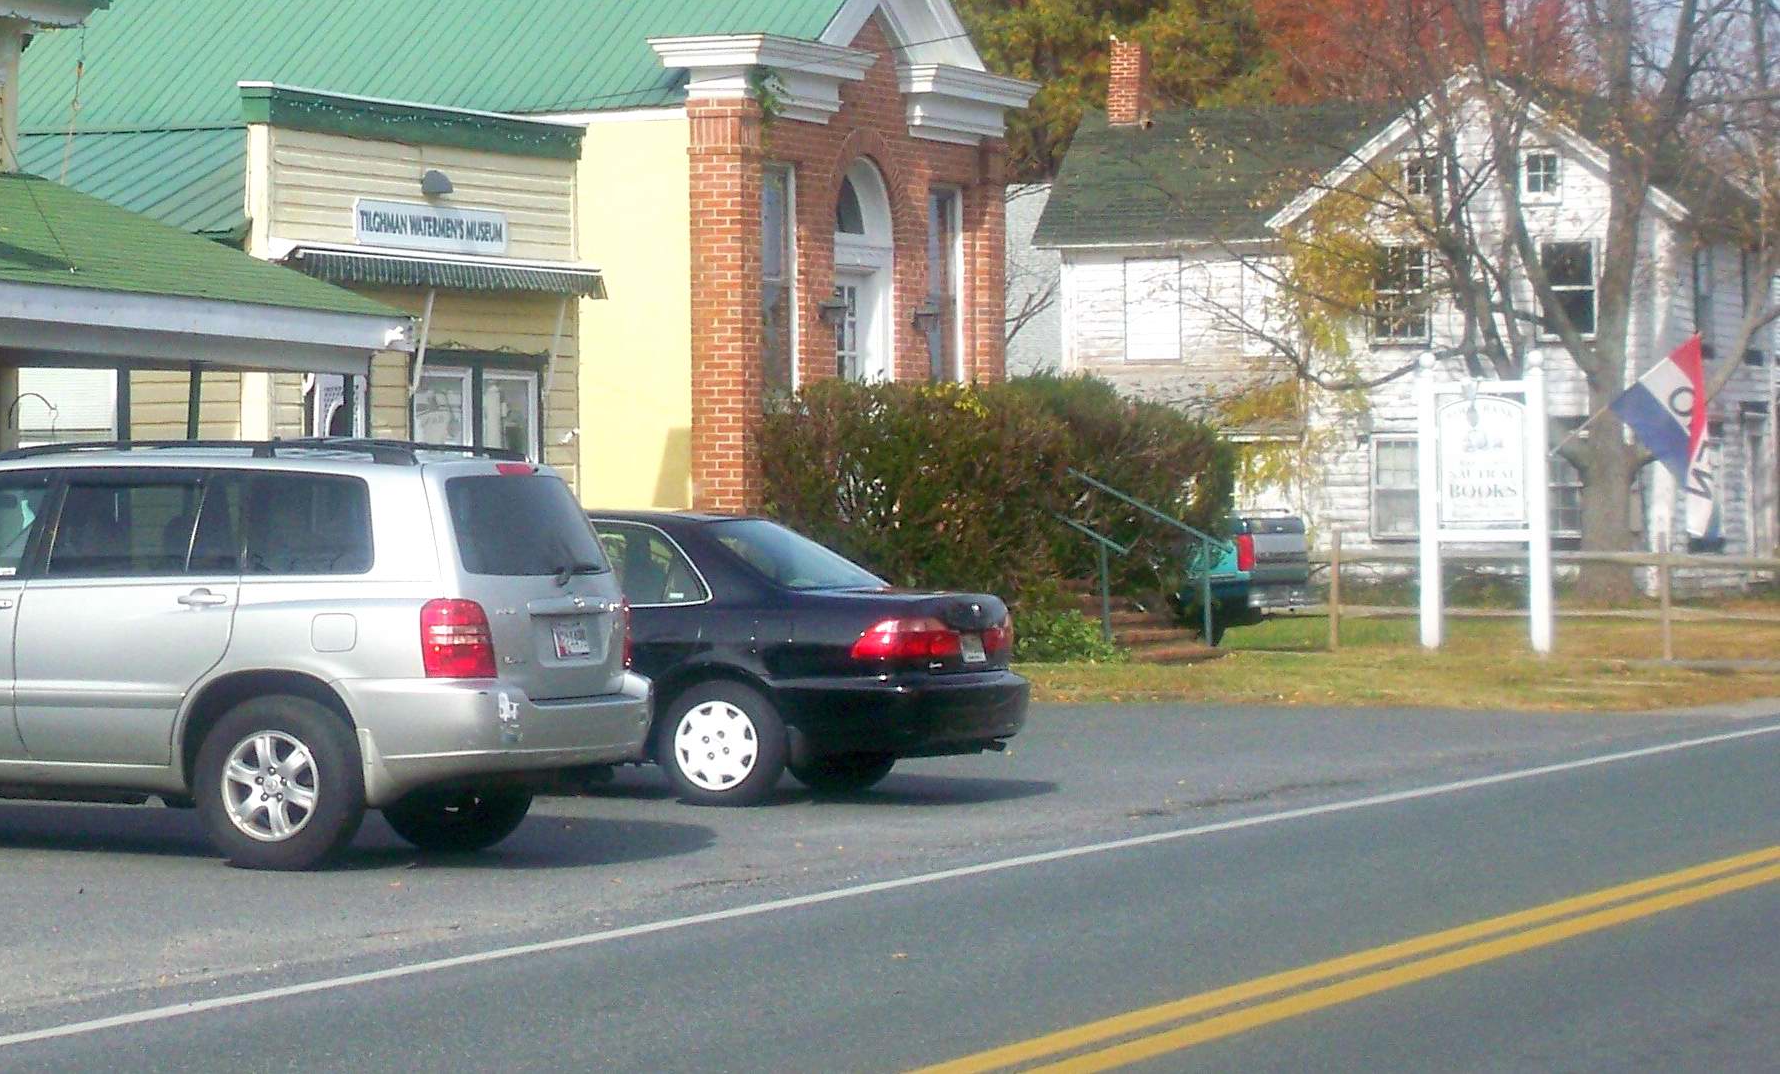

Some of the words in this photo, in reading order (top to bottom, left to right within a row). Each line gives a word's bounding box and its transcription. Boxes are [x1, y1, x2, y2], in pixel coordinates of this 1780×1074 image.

[359, 209, 408, 236] TILGHMAN
[409, 214, 465, 240] WATERMEN'S
[466, 219, 503, 243] MUSEUM
[1449, 483, 1518, 499] BOOKS
